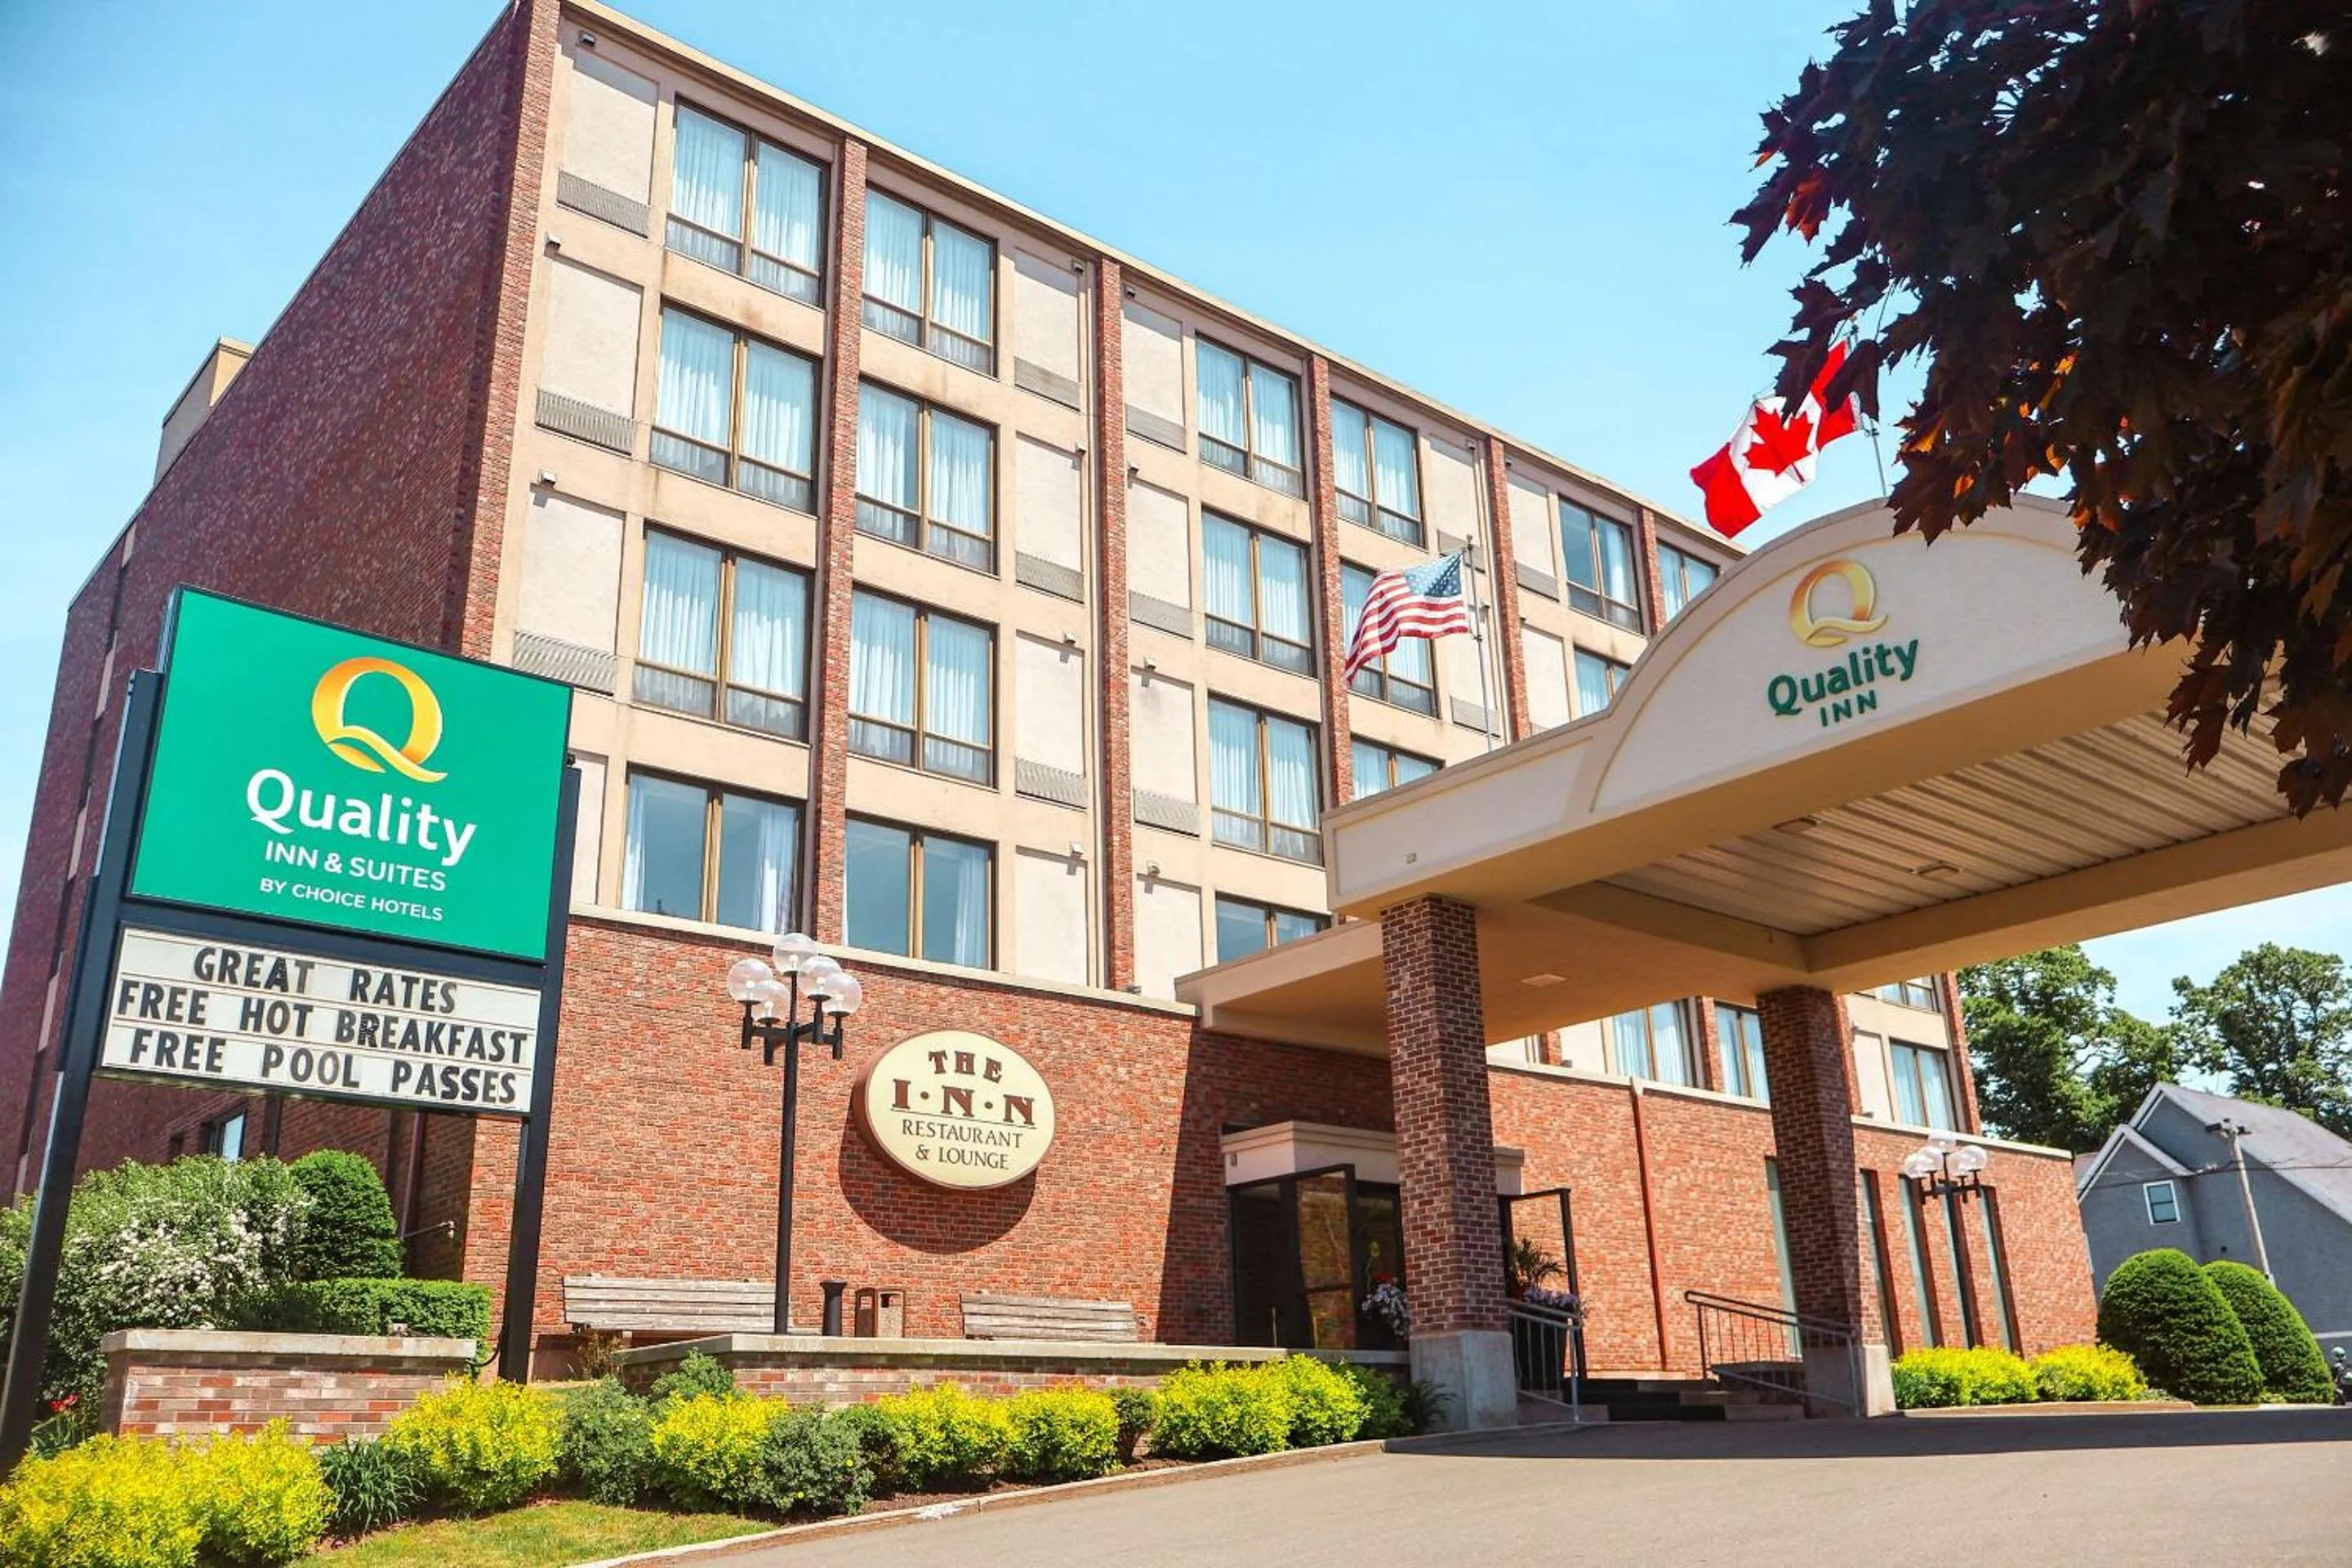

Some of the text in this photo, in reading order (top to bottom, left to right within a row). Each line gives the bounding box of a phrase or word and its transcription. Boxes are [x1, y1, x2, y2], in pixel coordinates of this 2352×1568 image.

[1768, 639, 1918, 716] Quality
[1820, 690, 1877, 727] INN
[247, 768, 476, 866] Quality
[265, 840, 447, 891] INN & SUITES
[260, 878, 443, 921] BY CHOICE HOTELS
[194, 947, 457, 1013] GREAT RATES
[118, 980, 528, 1064] FREE HOT BREAKFAST
[131, 1029, 515, 1105] FREE POOL PASSES
[929, 1050, 1002, 1084] THE
[902, 1119, 1022, 1148] RESTAURANT
[915, 1144, 1009, 1170] & LOUNGE
